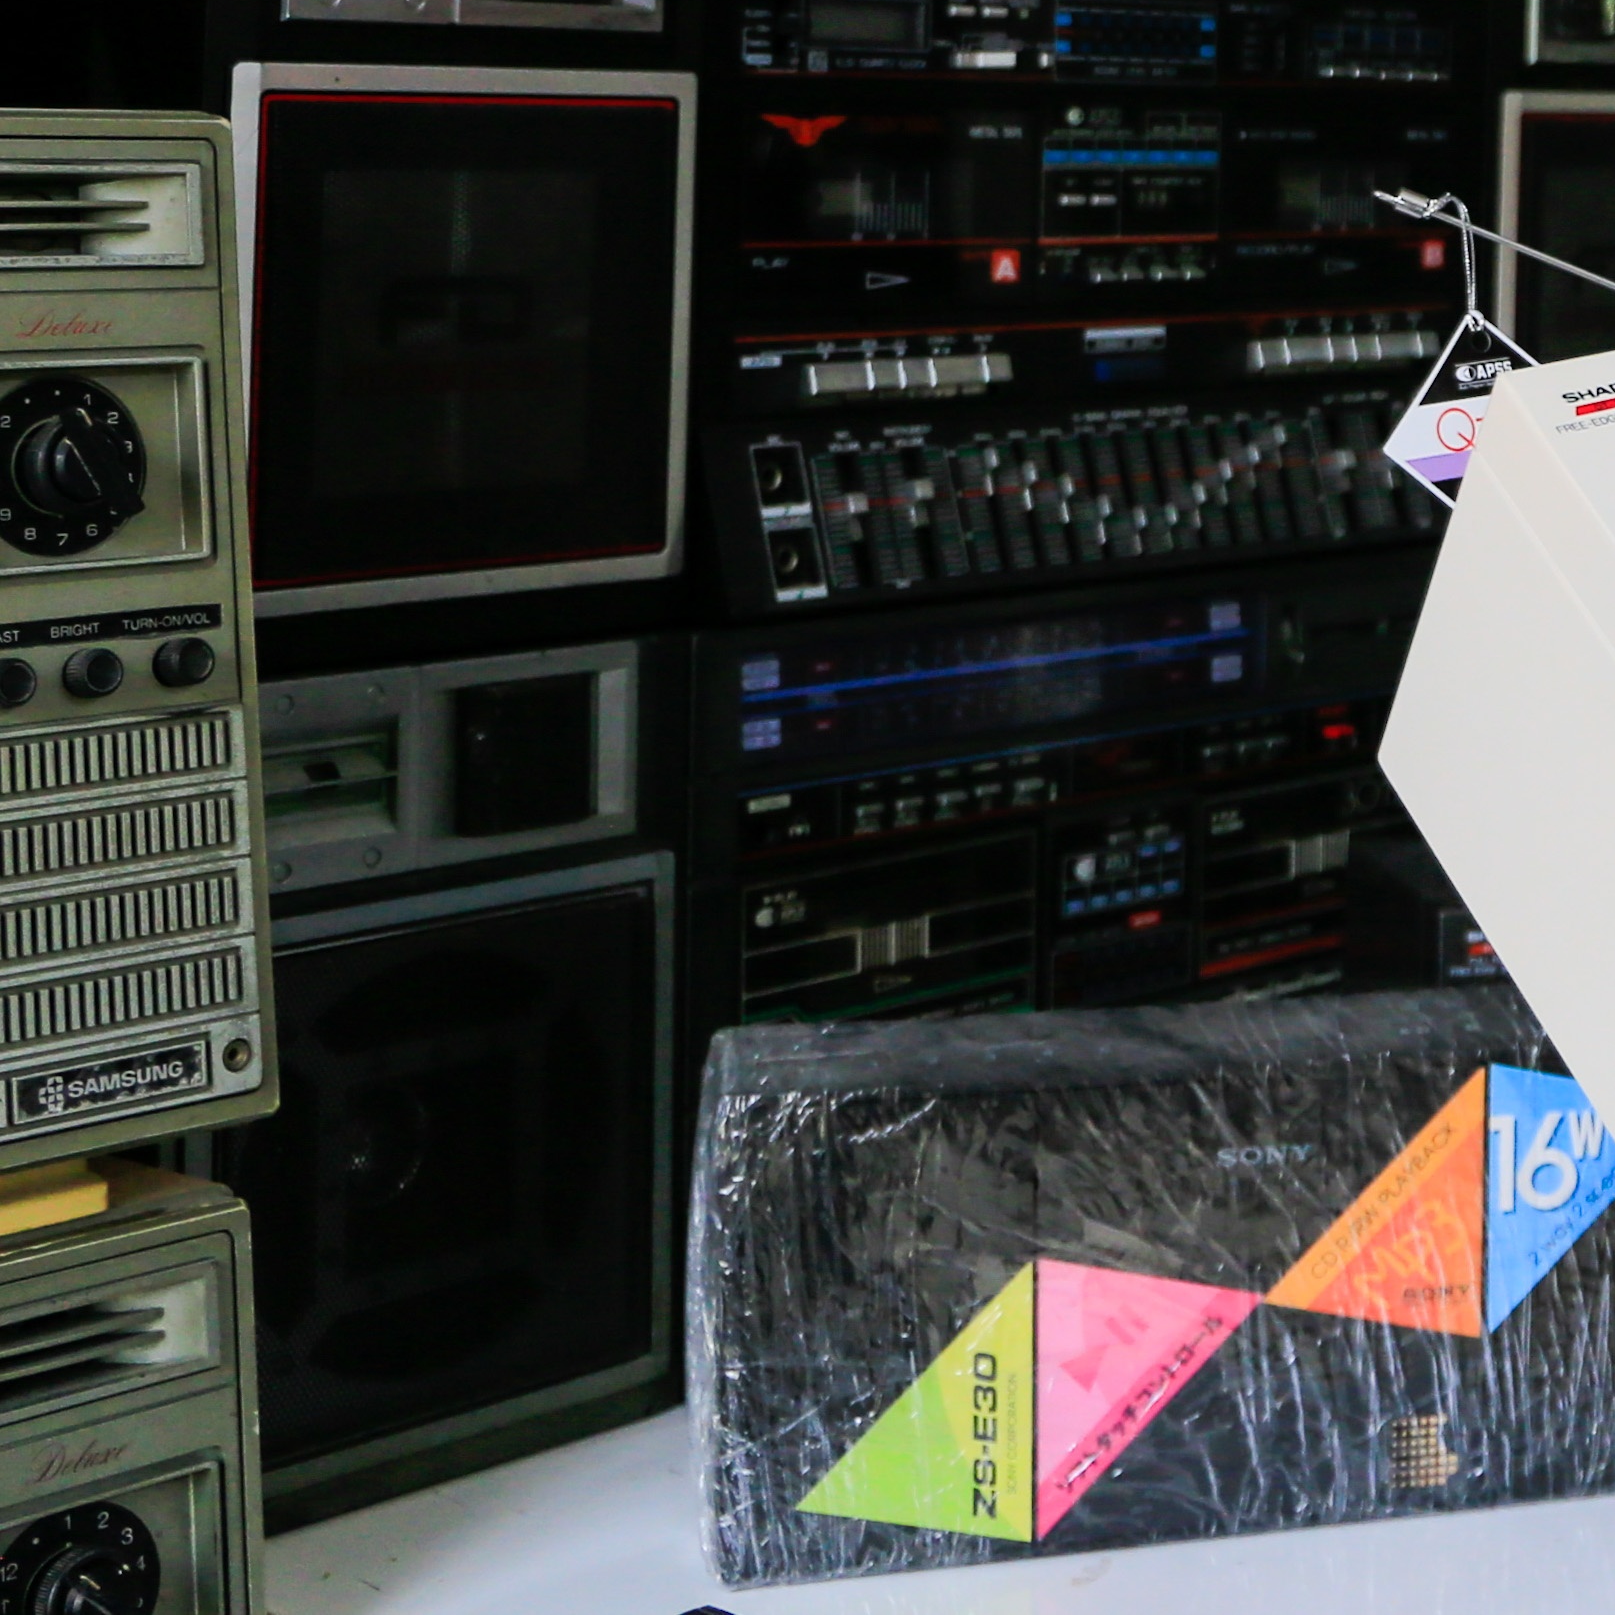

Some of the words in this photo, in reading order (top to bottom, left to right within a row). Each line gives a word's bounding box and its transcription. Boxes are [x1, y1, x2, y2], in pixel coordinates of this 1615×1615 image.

[1477, 361, 1513, 379] APSS
[83, 394, 92, 405] 1
[107, 412, 119, 424] 2
[24, 527, 37, 540] 8
[86, 524, 98, 536] 6
[57, 533, 69, 546] 7
[50, 622, 100, 638] BRIGHT
[122, 612, 211, 631] TURN-ON/VOL
[68, 1061, 184, 1098] SAMSUNG
[973, 1352, 997, 1519] ZS-E30
[64, 1515, 72, 1529] 1
[97, 1511, 110, 1529] 2
[121, 1527, 134, 1545] 3
